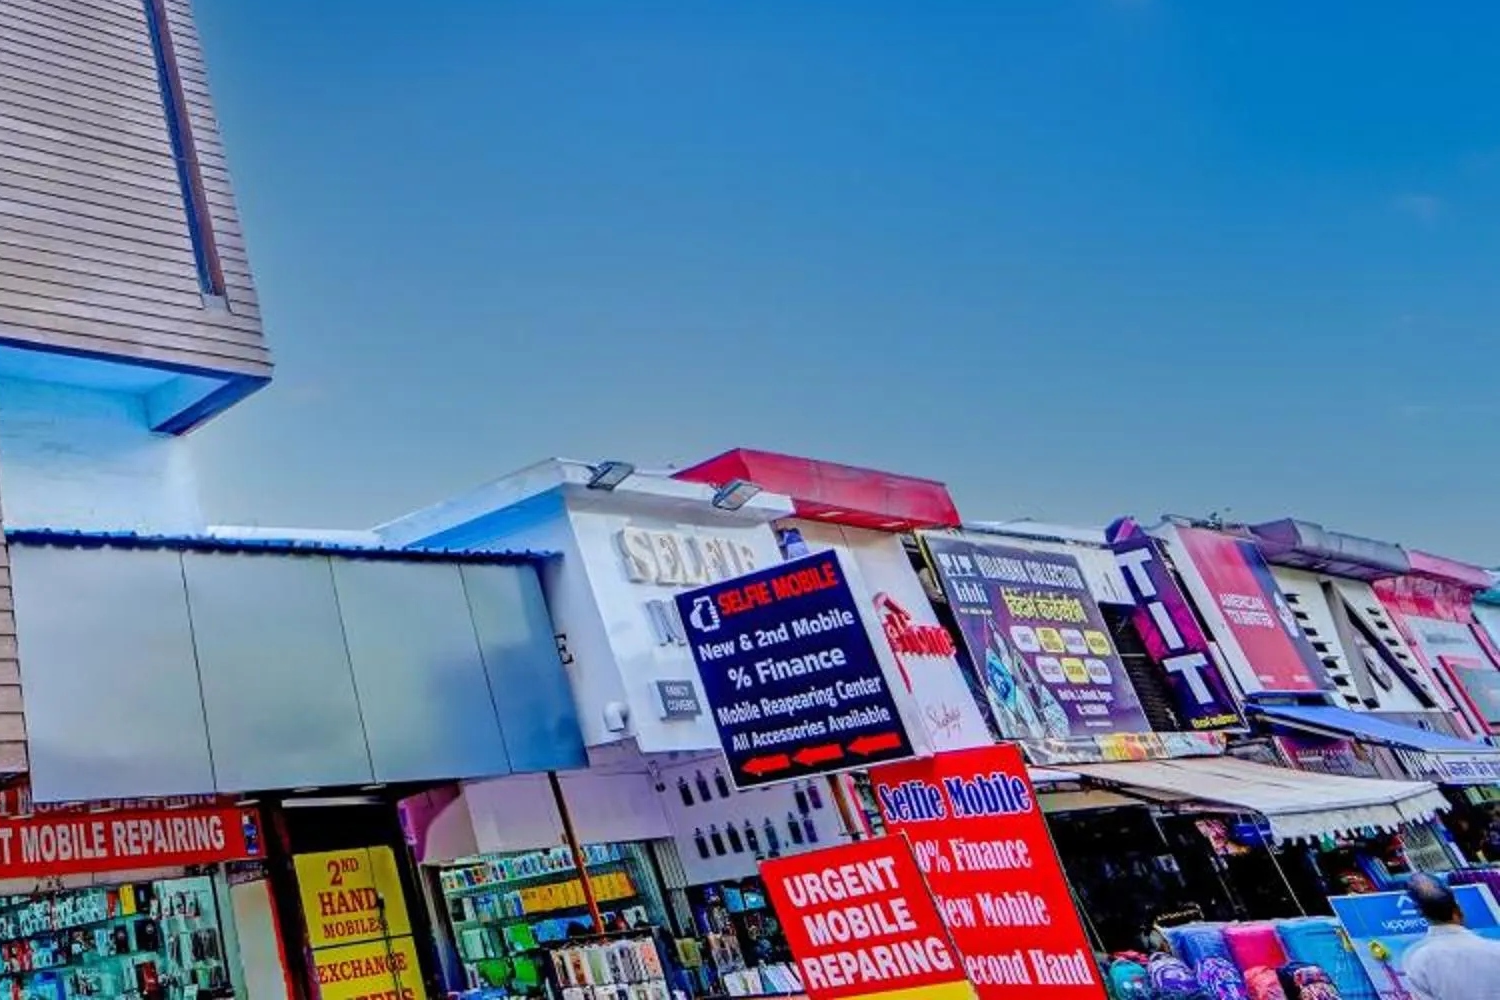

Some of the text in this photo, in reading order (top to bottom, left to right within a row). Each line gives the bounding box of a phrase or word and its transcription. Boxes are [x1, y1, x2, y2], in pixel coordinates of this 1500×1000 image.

[718, 562, 838, 616] SELFIE MOBILE
[698, 608, 855, 662] New & 2nd Mobile
[728, 648, 846, 690] % Finance
[718, 676, 882, 726] Mobile Reapearing Center
[732, 705, 891, 751] All Accessories Available
[878, 771, 1033, 824] Selfie Mobile
[20, 820, 108, 864] MOBILE
[113, 815, 225, 857] REPAIRING
[949, 839, 1033, 872] Finance
[318, 888, 379, 916] HAND
[783, 856, 899, 907] URGENT
[803, 898, 916, 946] MOBILE
[976, 891, 1051, 928] Mobile
[318, 953, 408, 985] EXCHANGE
[801, 937, 955, 990] REPARING
[965, 949, 1095, 986] econd Hand
